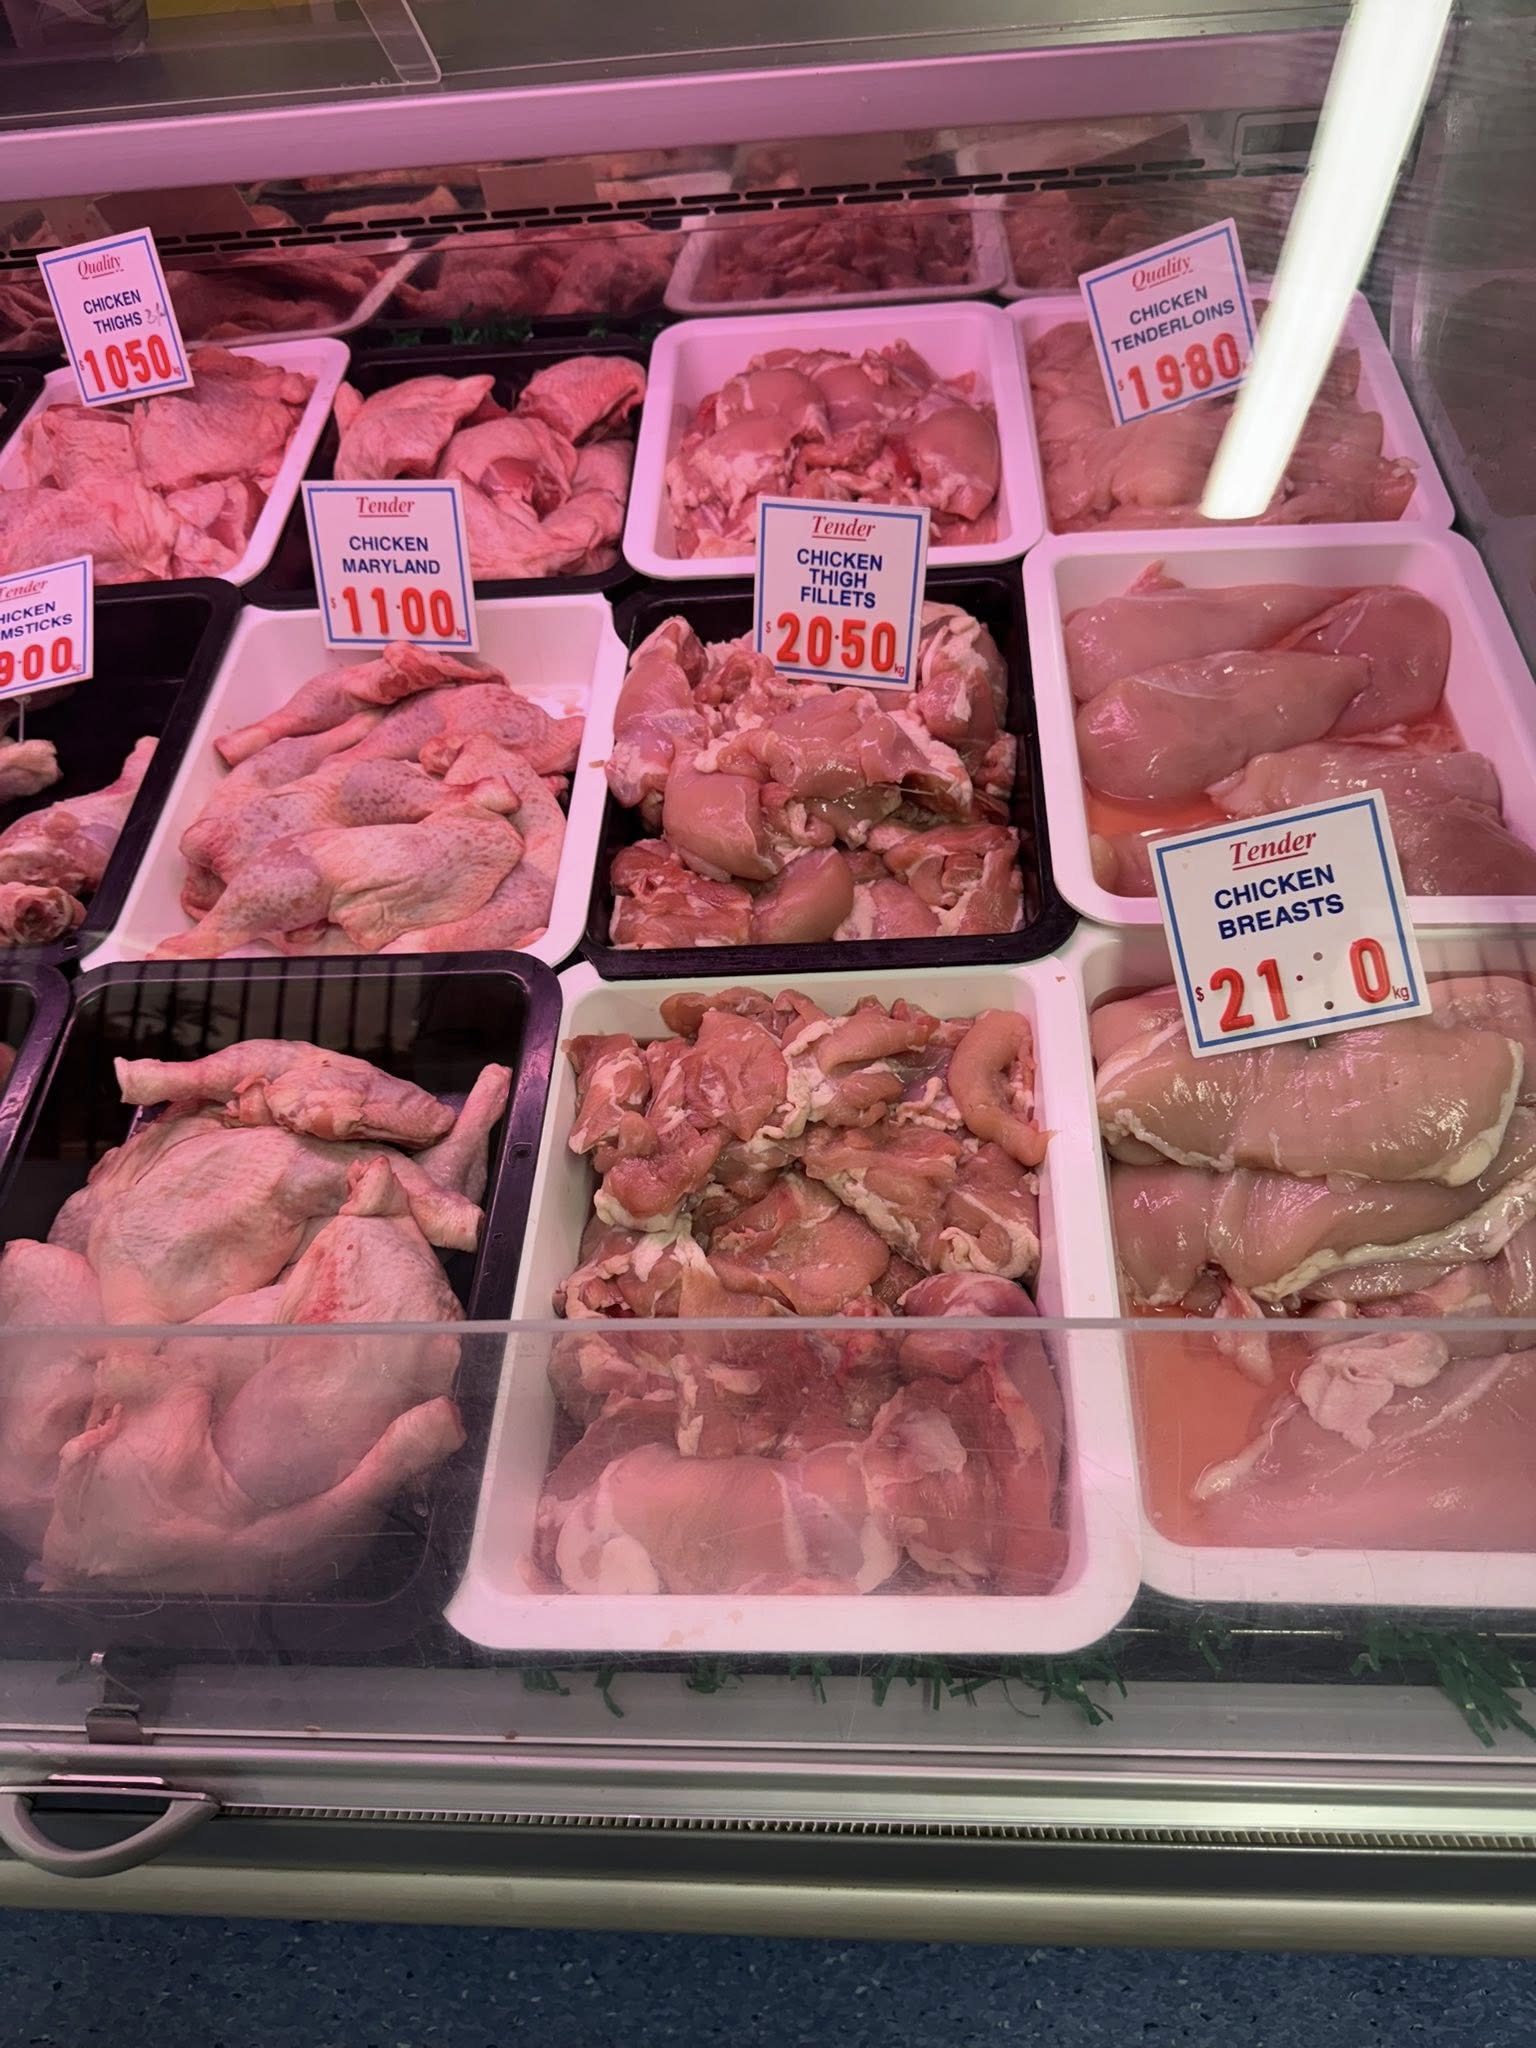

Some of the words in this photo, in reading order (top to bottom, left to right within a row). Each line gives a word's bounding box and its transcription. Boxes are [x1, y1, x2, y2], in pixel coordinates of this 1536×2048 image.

[78, 254, 124, 280] Quality
[1132, 256, 1193, 291] Quality
[83, 289, 141, 314] CHICKEN
[1129, 286, 1208, 325] CHICKEN
[94, 312, 142, 334] THIGHS
[1112, 299, 1235, 353] TENDERLOINS
[356, 496, 415, 516] Tender
[811, 515, 876, 540] Tender
[349, 536, 429, 552] CHICKEN
[342, 558, 440, 574] MARYLAND
[797, 549, 883, 571] CHICKEN
[809, 568, 867, 589] THIGH
[800, 586, 876, 609] FILLETS
[0, 601, 56, 624] HICKEN
[0, 613, 73, 640] MSTICKS
[1229, 831, 1317, 869] Tender
[1214, 863, 1335, 910] CHICKEN
[1217, 893, 1344, 940] BREASTS
